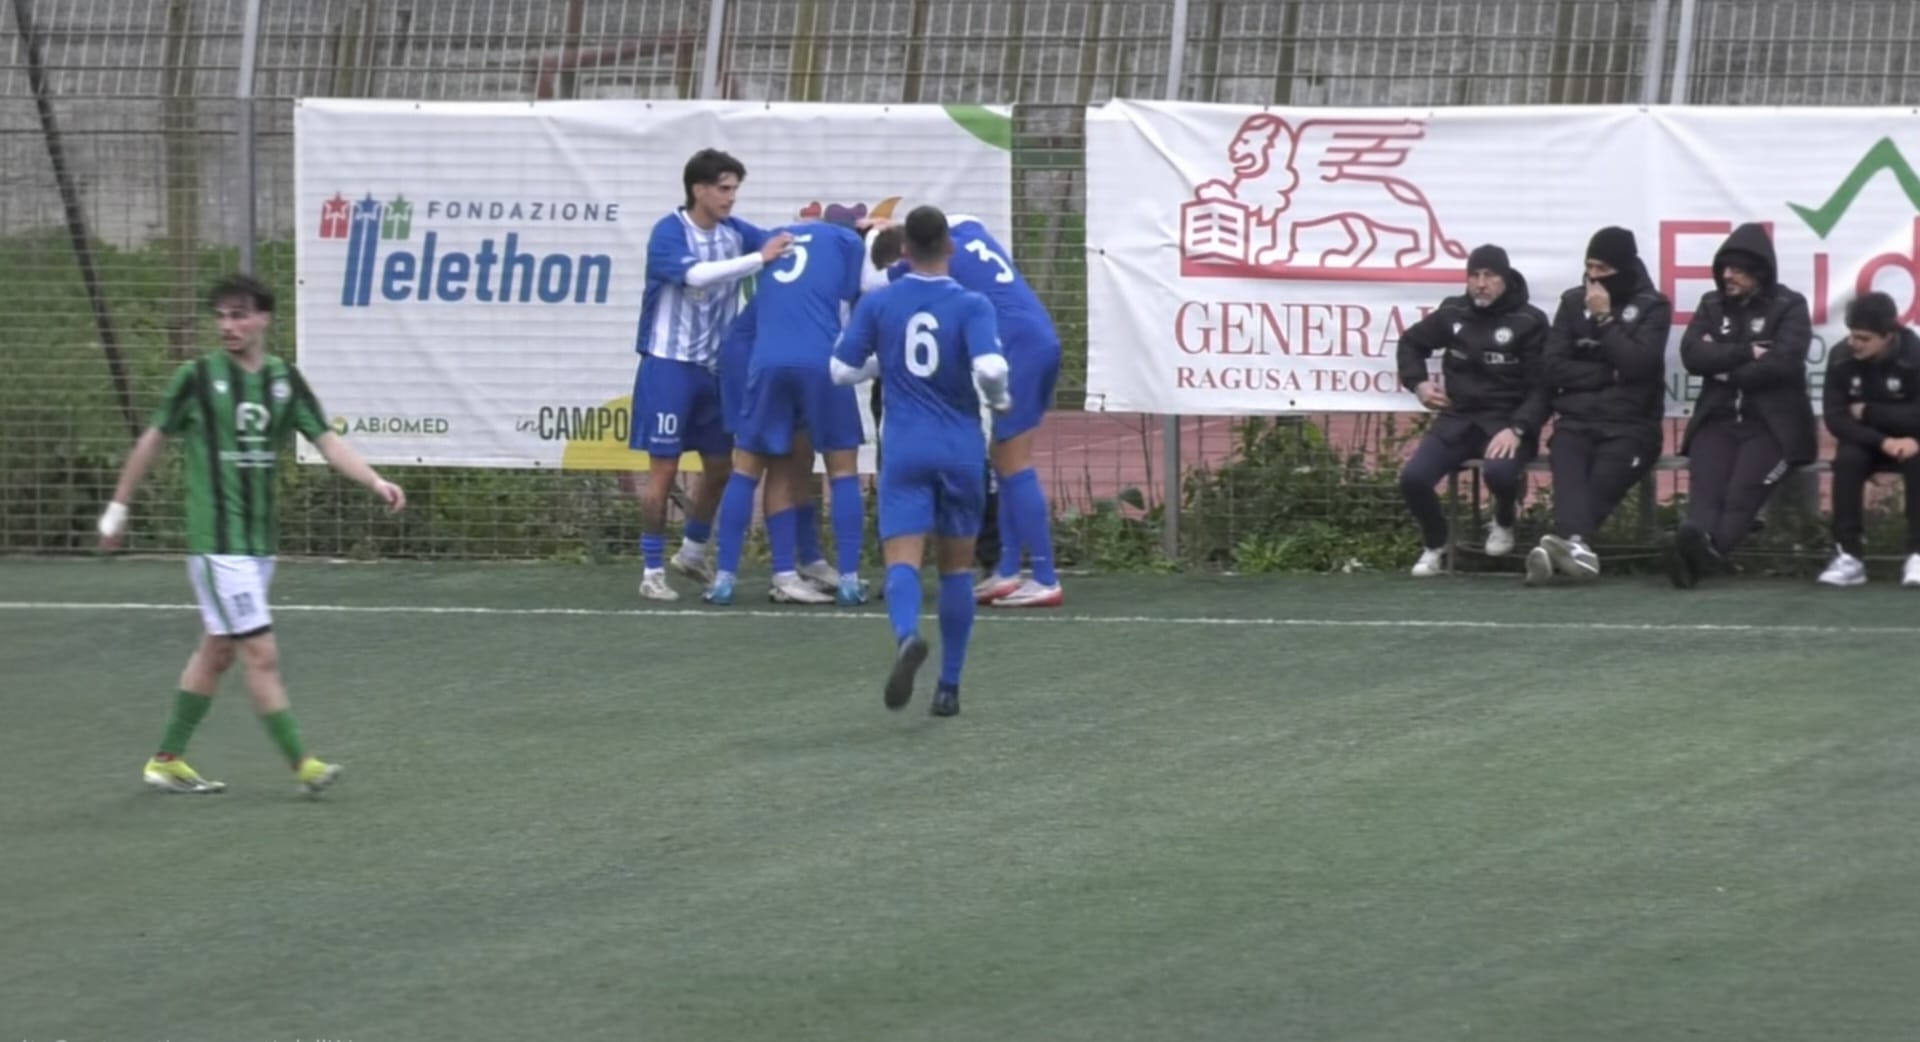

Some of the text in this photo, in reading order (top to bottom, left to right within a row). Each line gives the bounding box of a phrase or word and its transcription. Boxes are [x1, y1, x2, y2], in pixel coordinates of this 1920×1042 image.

[427, 201, 620, 222] FONDAZIONE
[319, 192, 612, 306] Telethon
[772, 234, 813, 283] 5
[965, 239, 1015, 283] 3
[1659, 216, 1920, 325] Eid
[905, 312, 940, 378] 6
[1174, 300, 1435, 358] GENERA
[1176, 366, 1300, 391] RAGUSA
[656, 412, 677, 435] 10
